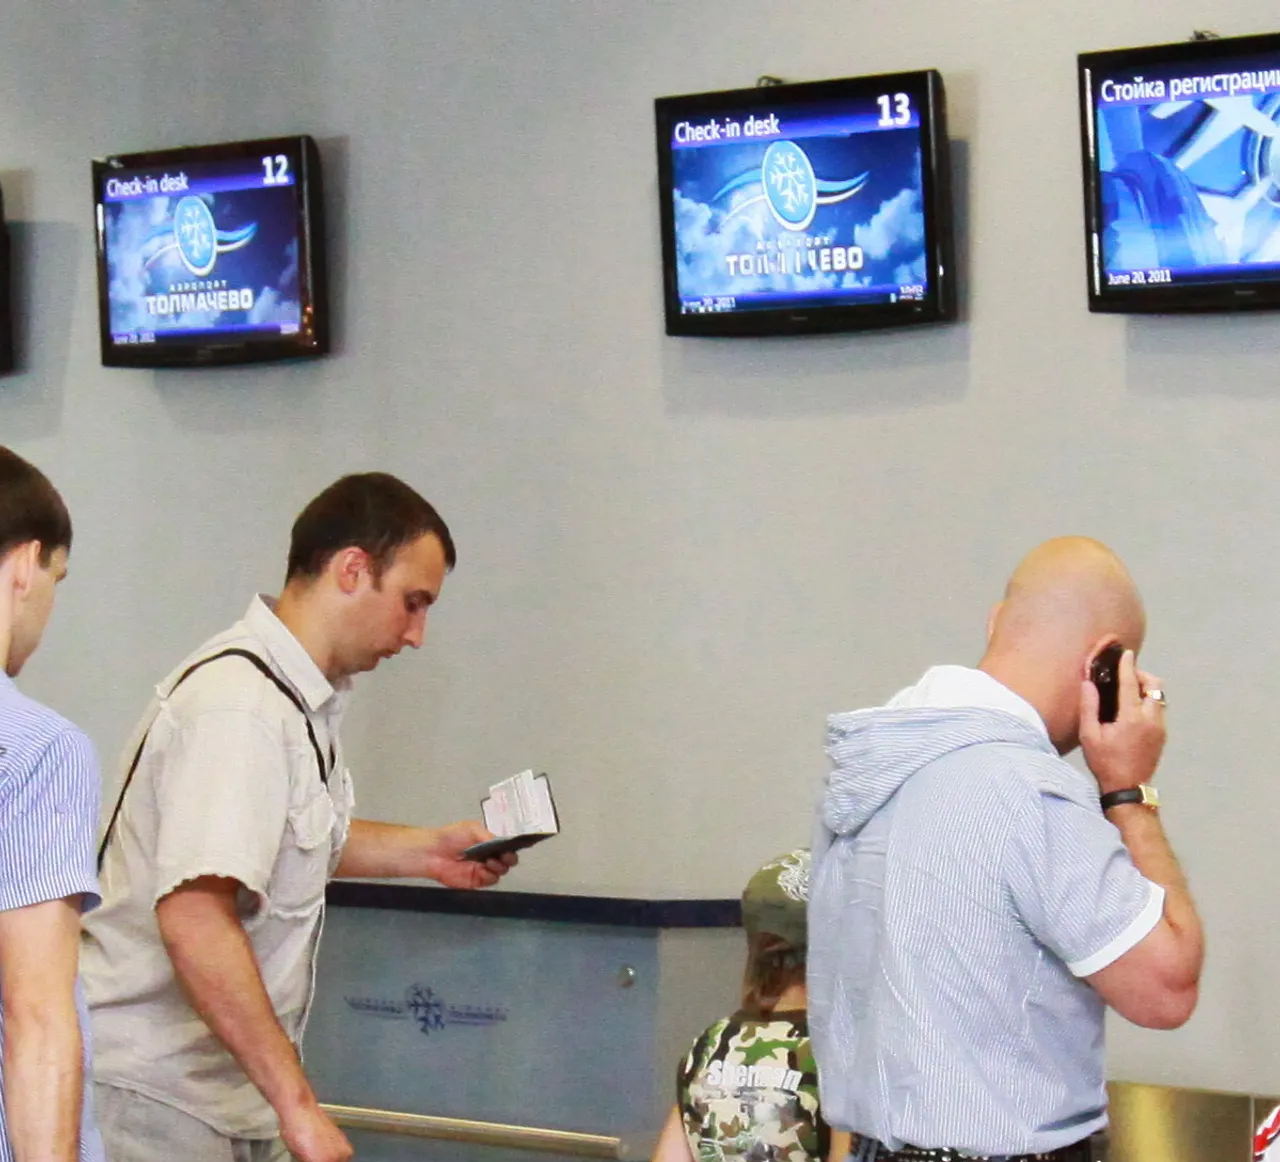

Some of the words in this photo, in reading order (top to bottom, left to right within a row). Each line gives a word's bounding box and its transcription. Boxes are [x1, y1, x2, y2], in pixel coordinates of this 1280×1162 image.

[1101, 76, 1165, 102] Стойка
[877, 93, 911, 127] 13
[674, 117, 740, 143] Check-in
[744, 113, 780, 137] desk
[262, 154, 289, 185] 12
[106, 176, 158, 198] Check-in
[160, 172, 189, 193] desk
[146, 288, 253, 315] ТОЛМАЧЕВО
